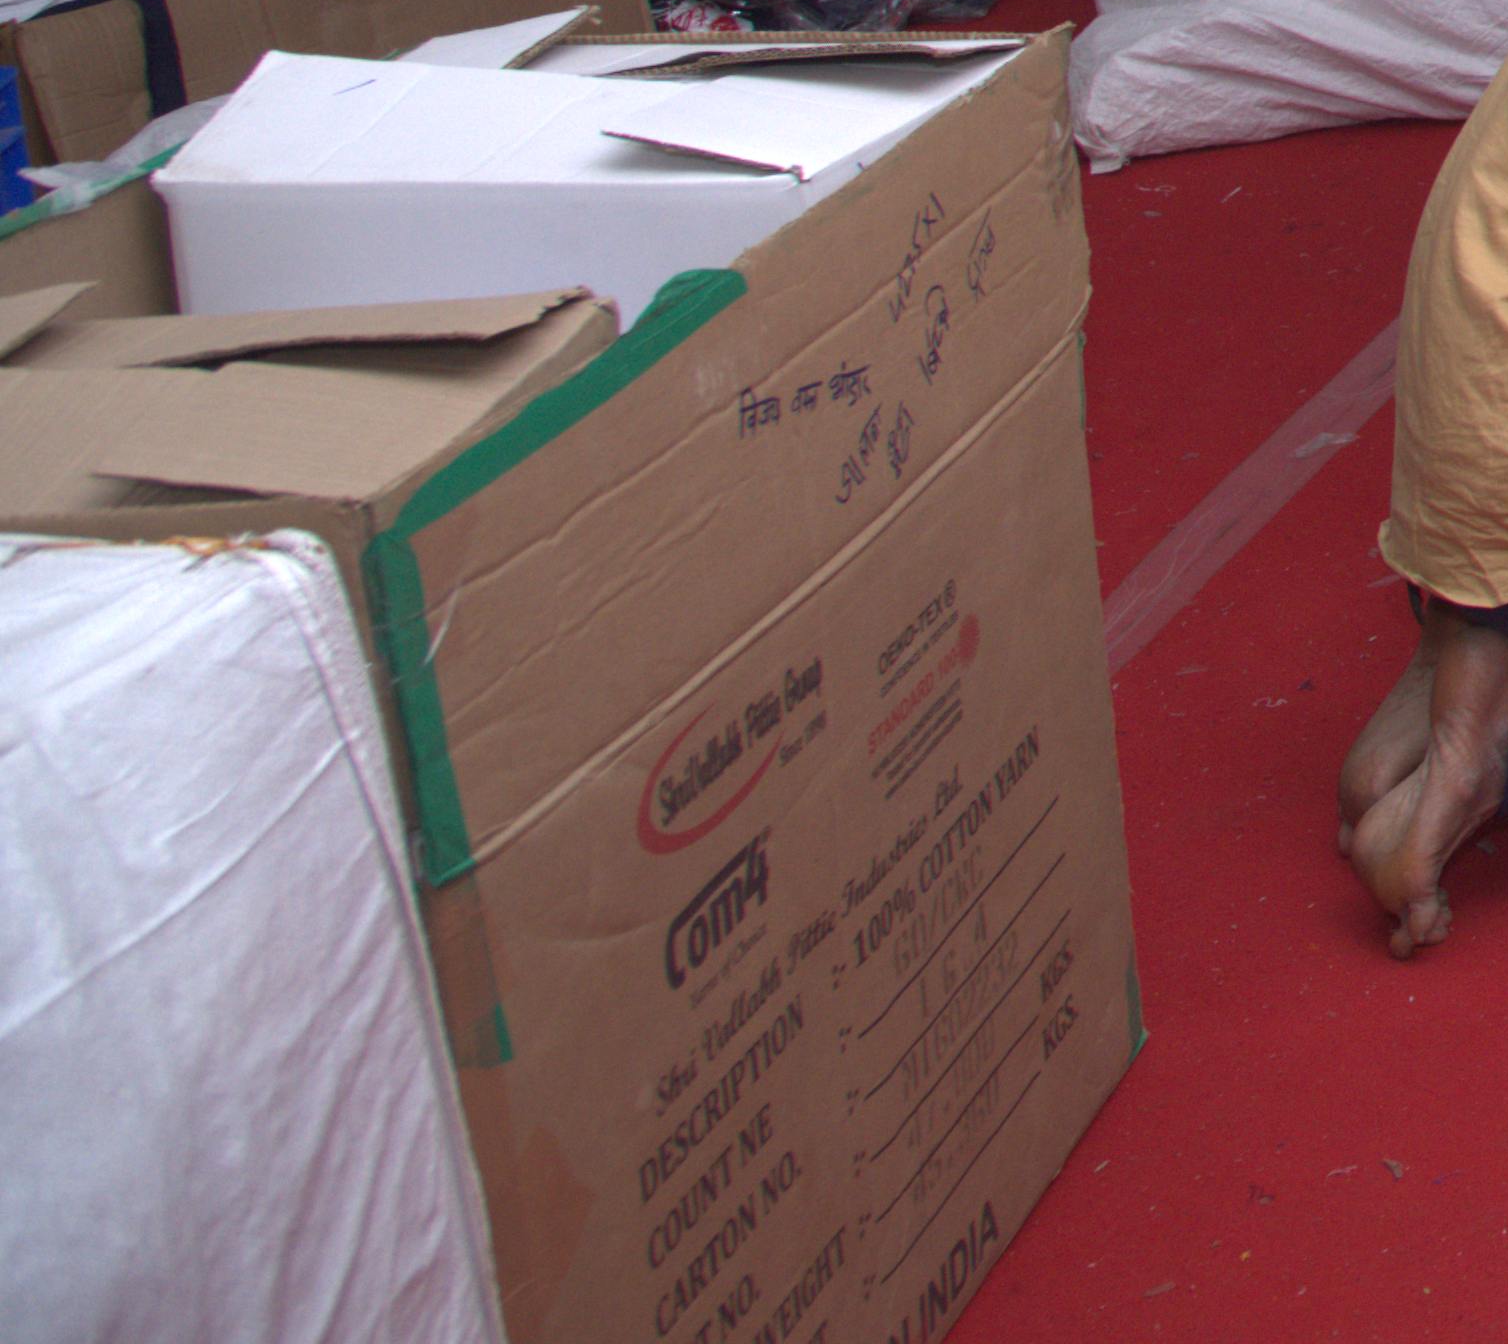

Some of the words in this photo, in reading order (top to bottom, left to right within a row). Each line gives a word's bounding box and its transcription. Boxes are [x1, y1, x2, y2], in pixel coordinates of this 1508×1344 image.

[840, 817, 930, 920] Industries
[638, 993, 804, 1206] DESCRIPTION
[851, 884, 917, 969] 100%
[918, 786, 993, 895] COTTON
[993, 724, 1041, 804] YARN
[648, 1143, 733, 1271] COUNT
[738, 1103, 774, 1168] NE
[655, 1191, 757, 1340] CARTON
[761, 1150, 804, 1216] NO.
